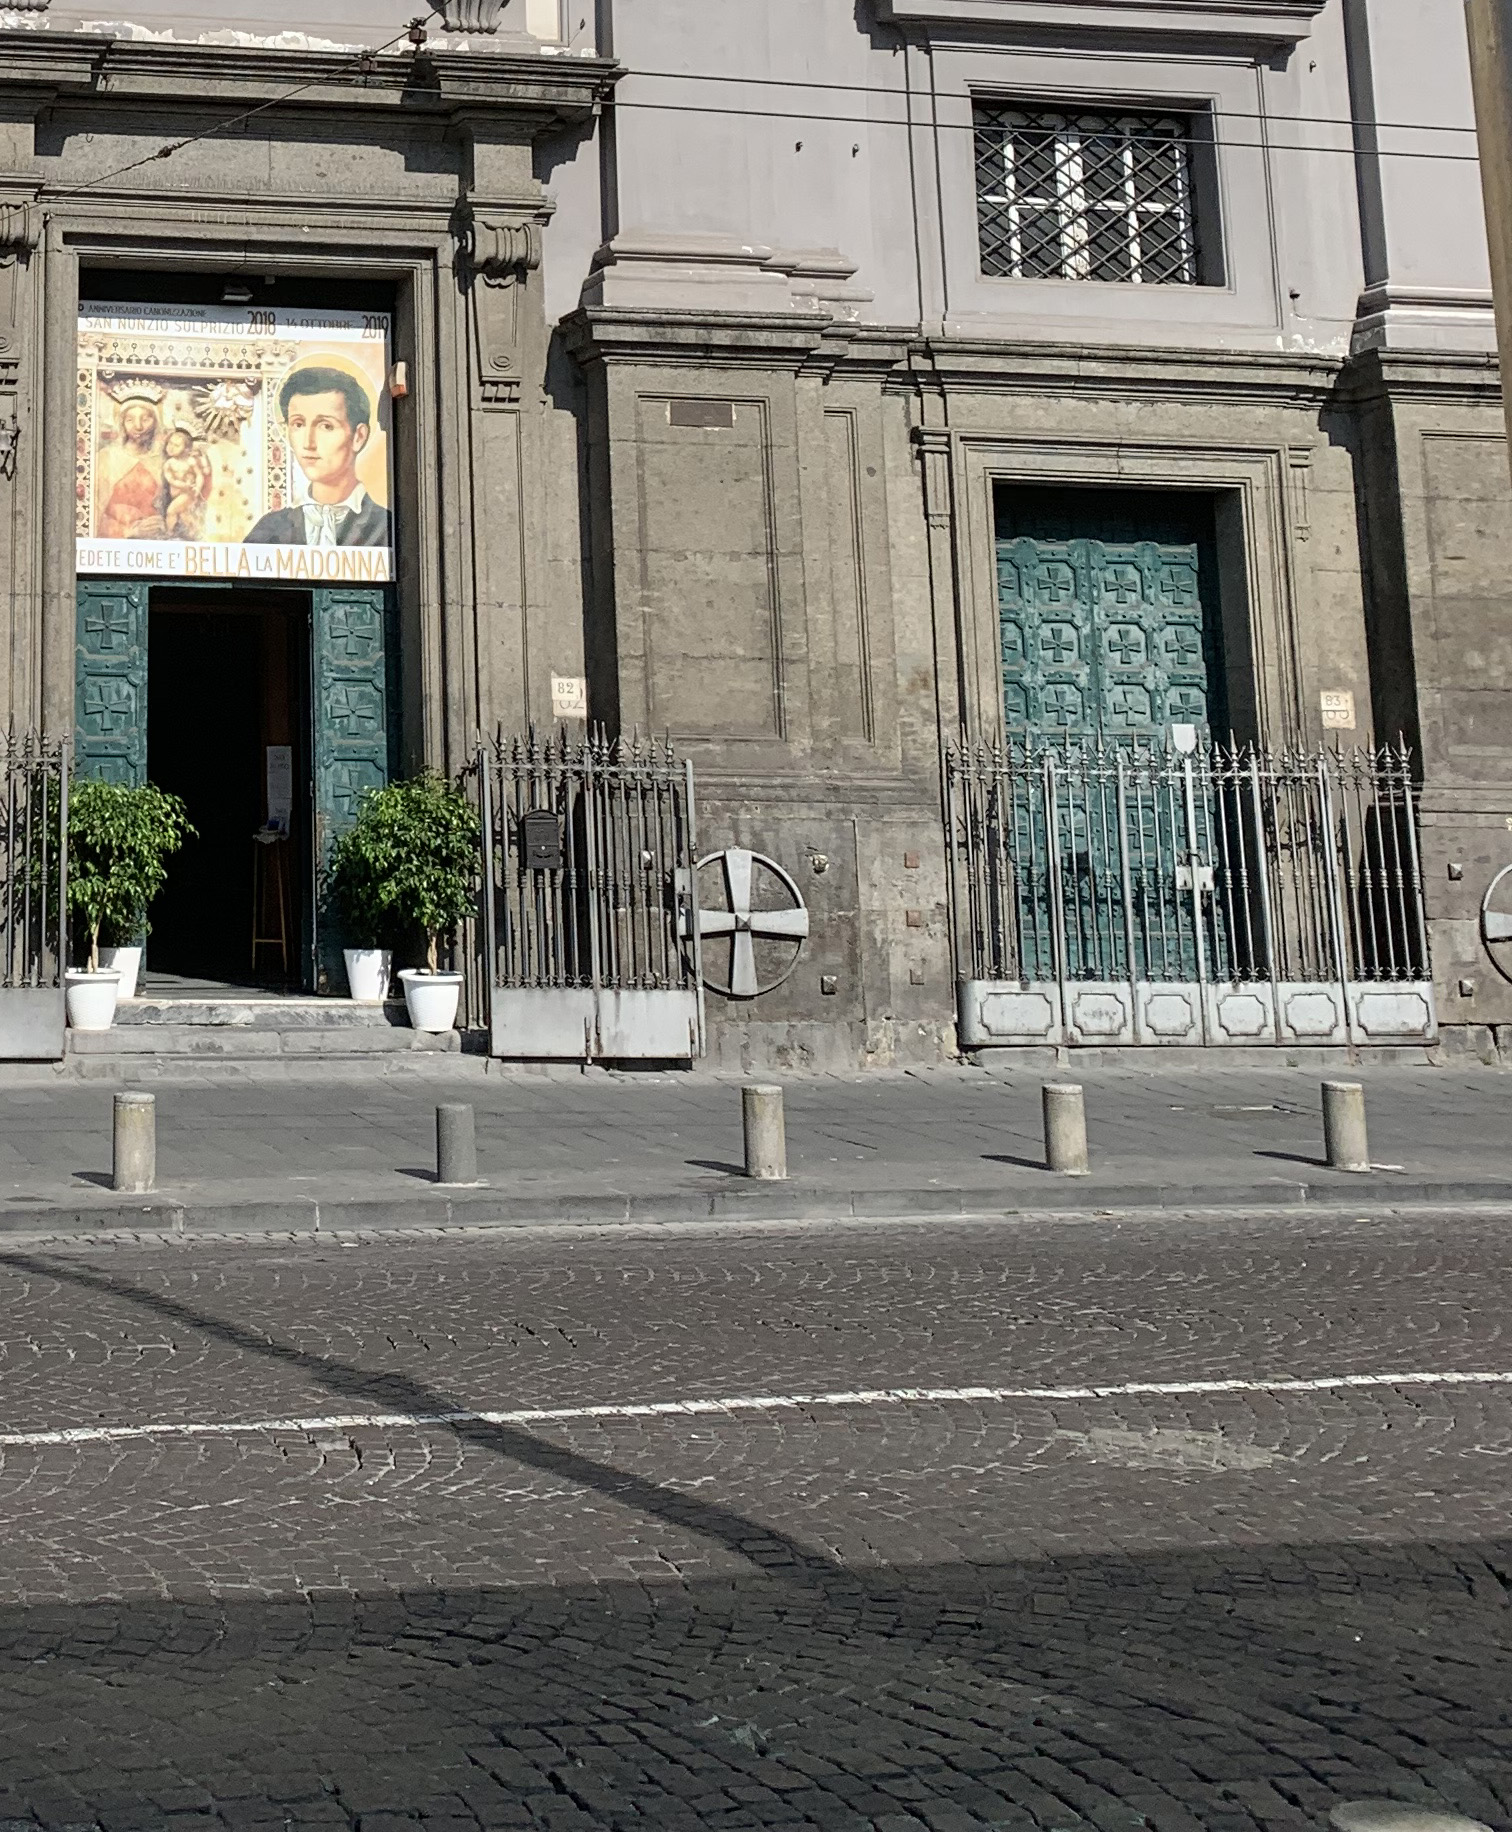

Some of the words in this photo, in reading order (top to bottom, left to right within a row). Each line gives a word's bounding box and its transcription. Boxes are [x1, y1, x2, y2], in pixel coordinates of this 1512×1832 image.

[88, 304, 142, 316] ANNIVERSARIO
[85, 316, 112, 329] SAN
[118, 317, 169, 331] NUNZIO
[174, 319, 244, 335] SULPRIZIO
[247, 310, 276, 336] 2018
[286, 318, 297, 328] 14
[300, 318, 354, 330] OTTOBRE
[361, 314, 389, 339] 2019
[76, 549, 121, 568] EDETE
[127, 551, 163, 569] COME
[169, 552, 181, 569] E'
[185, 546, 251, 577] BELLA
[256, 555, 273, 572] LA
[276, 549, 389, 581] MADONNA
[558, 682, 574, 694] 82
[1325, 694, 1341, 706] 83
